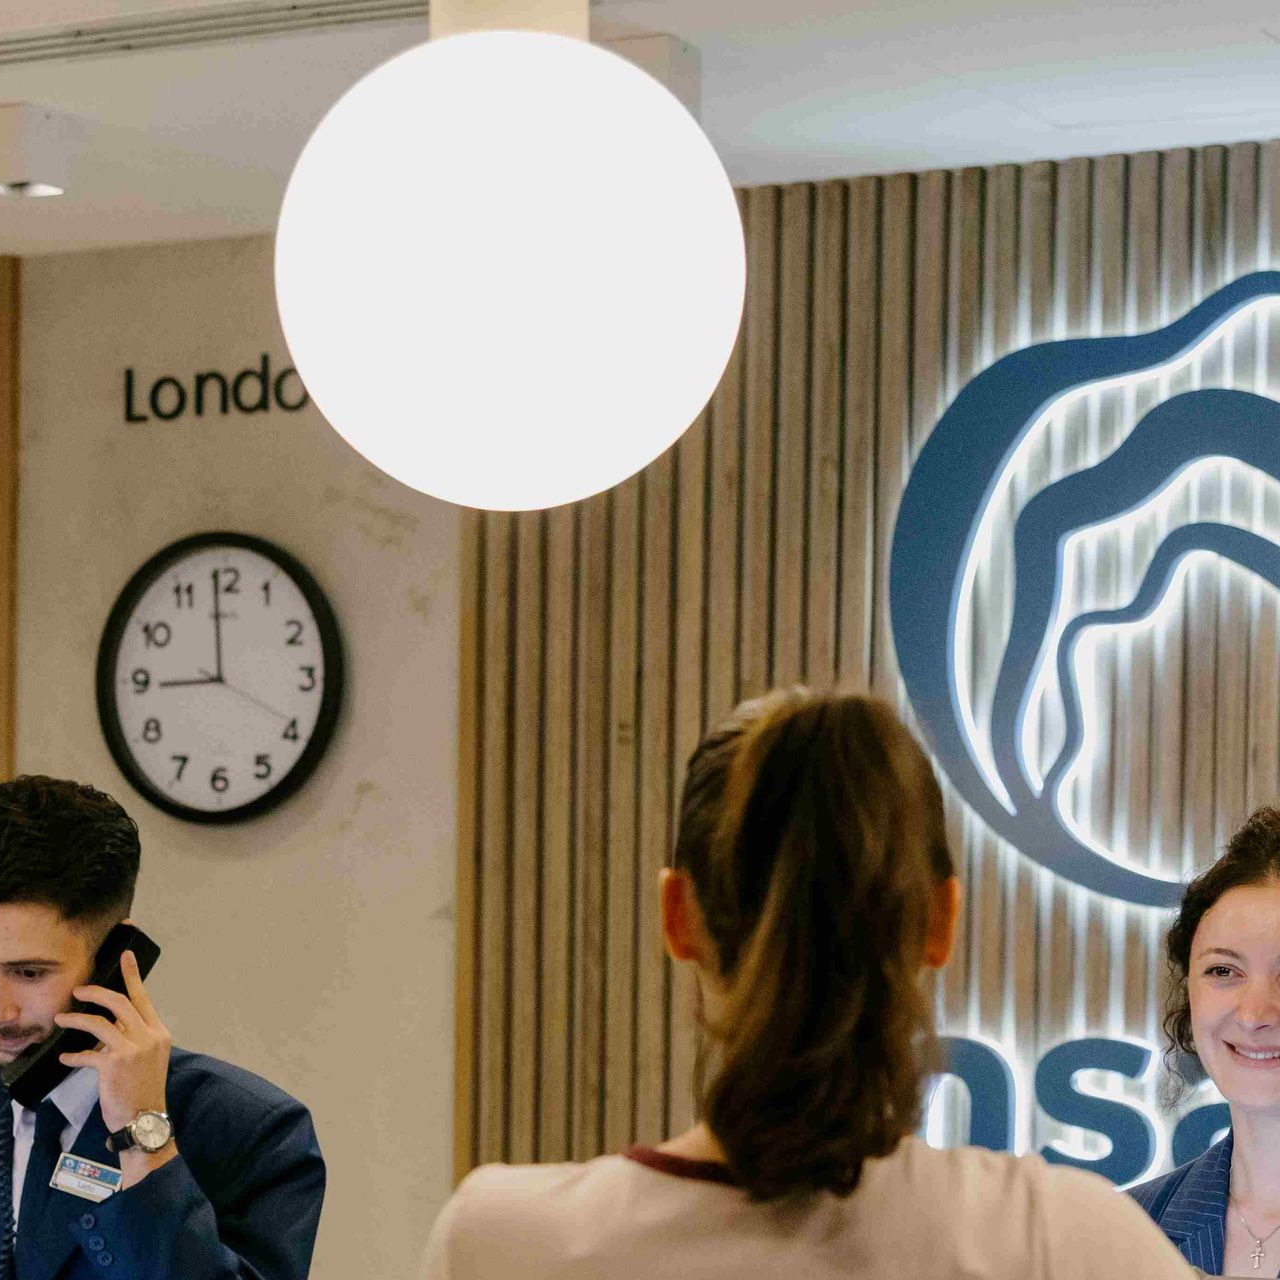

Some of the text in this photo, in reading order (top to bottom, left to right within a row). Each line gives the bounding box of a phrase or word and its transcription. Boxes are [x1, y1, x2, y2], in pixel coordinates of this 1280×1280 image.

[124, 352, 310, 423] Londo
[174, 583, 193, 609] 11
[261, 580, 271, 606] 1
[143, 621, 172, 649] 10
[285, 619, 304, 646] 2
[131, 668, 150, 695] 9
[298, 664, 317, 692] 3
[142, 717, 162, 744] 8
[282, 717, 300, 742] 4
[171, 754, 189, 782] 7
[210, 766, 230, 793] 6
[253, 753, 272, 780] 5
